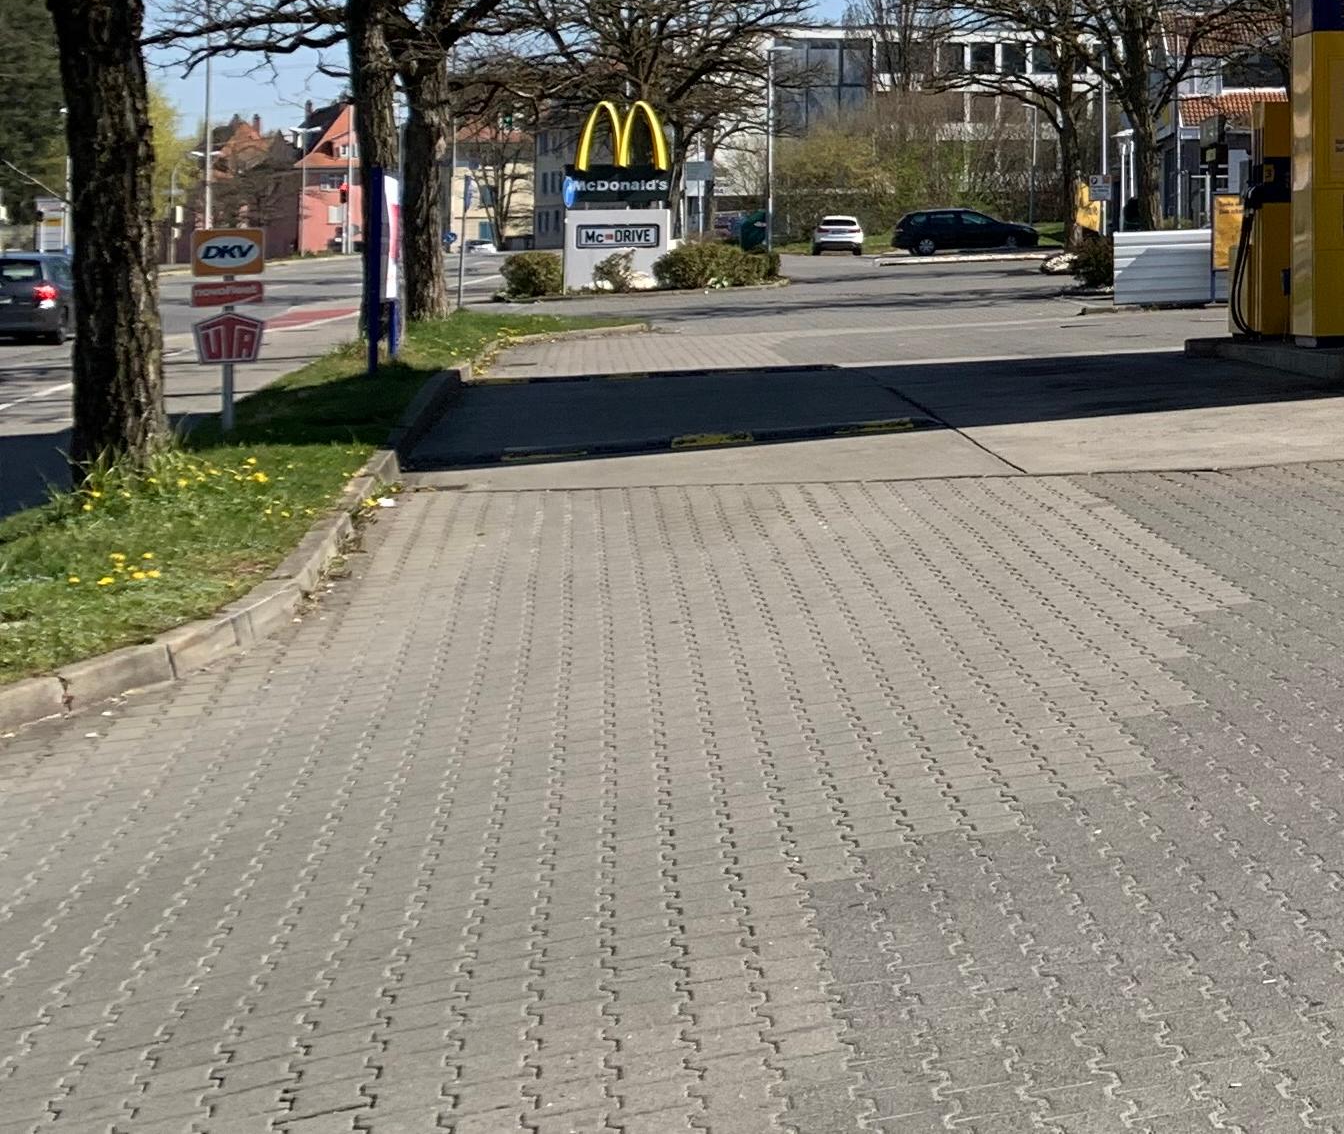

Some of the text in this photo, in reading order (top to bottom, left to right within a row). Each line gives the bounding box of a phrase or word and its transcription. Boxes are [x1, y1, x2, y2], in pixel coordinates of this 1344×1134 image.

[572, 180, 668, 192] McDonald's
[201, 244, 254, 260] DKV
[201, 325, 258, 360] UTA
